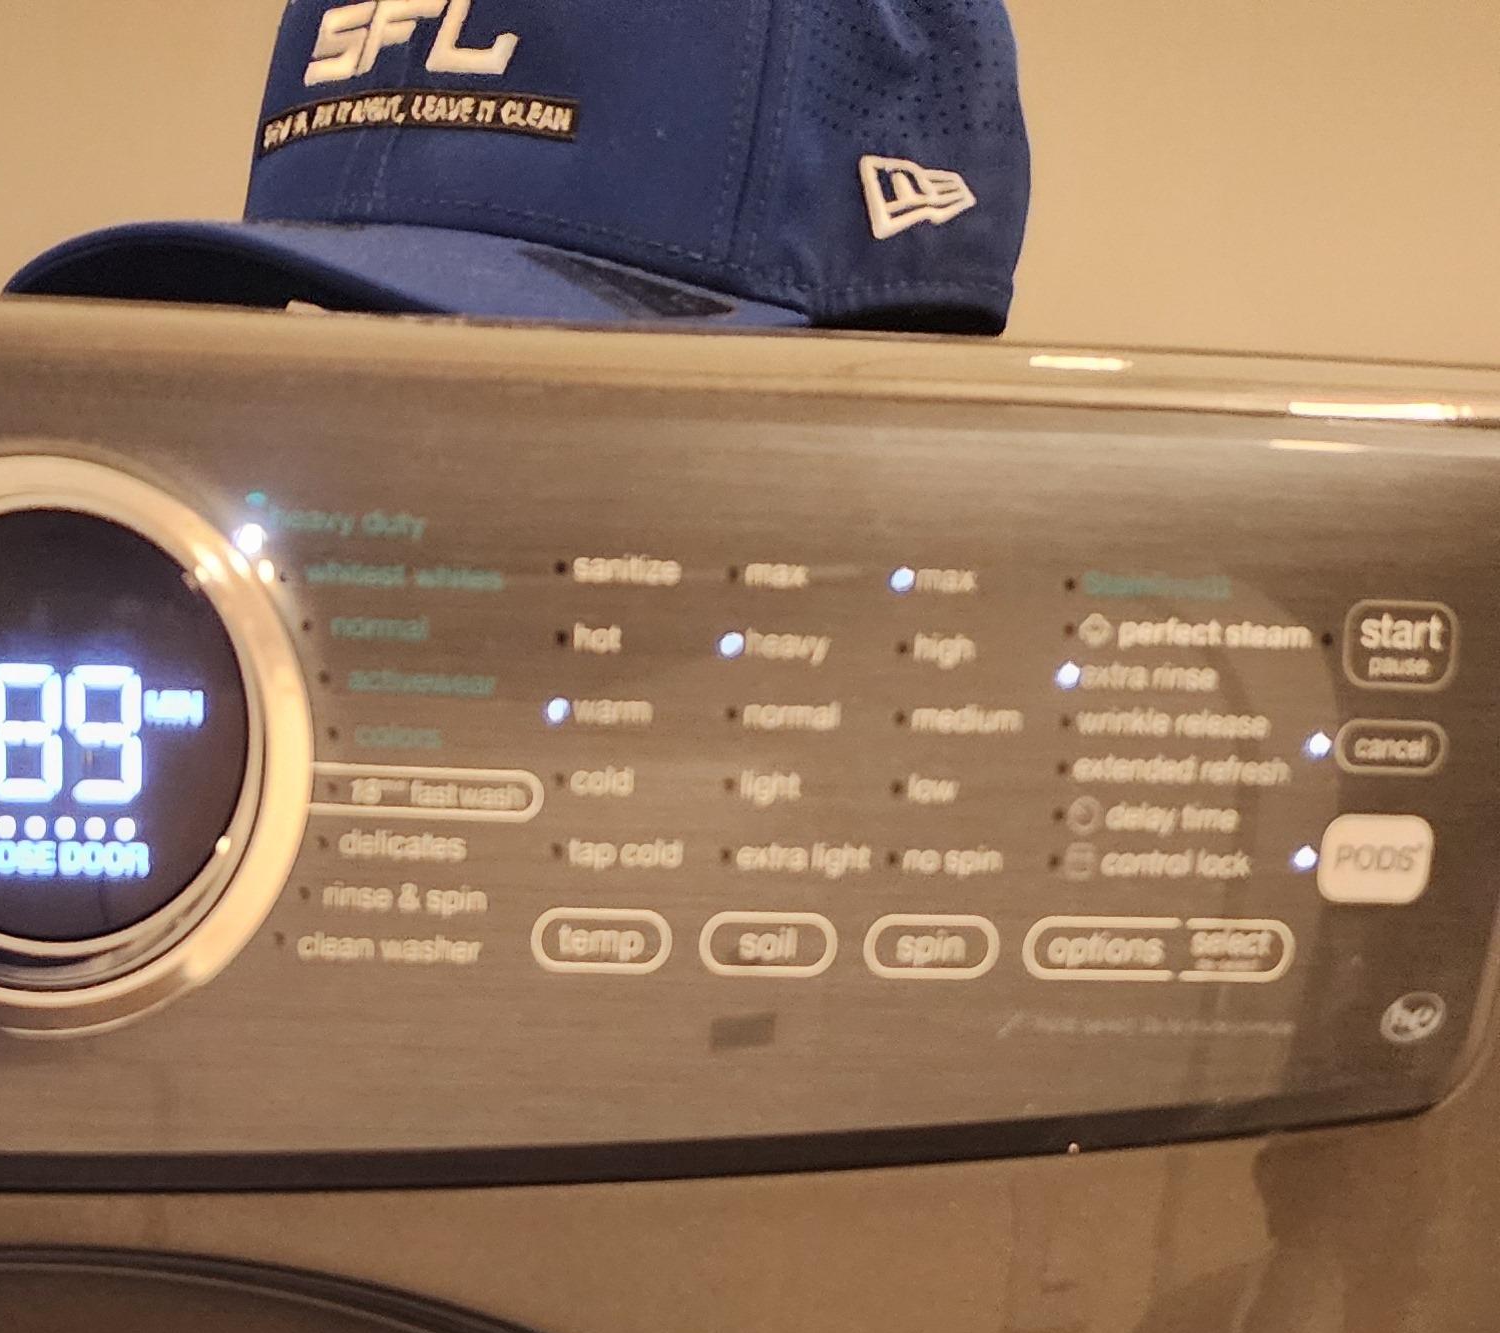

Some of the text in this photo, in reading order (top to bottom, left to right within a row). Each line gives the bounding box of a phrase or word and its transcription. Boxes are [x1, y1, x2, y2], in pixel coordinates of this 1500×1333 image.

[303, 0, 521, 87] SFL
[411, 95, 475, 125] LEAVE
[476, 99, 496, 124] IT
[501, 99, 574, 132] CLEAN
[573, 554, 682, 587] sanitize
[573, 622, 623, 654] hot
[746, 629, 832, 666] heavy
[1117, 617, 1312, 650] perfect steam
[1360, 612, 1444, 653] start
[913, 632, 977, 670] high
[1368, 656, 1432, 678] pause
[575, 699, 654, 726] warm
[742, 701, 842, 731] normal
[910, 704, 1024, 733] medium
[1353, 735, 1432, 763] cancel
[570, 766, 635, 798] cold
[739, 771, 802, 807] light
[907, 772, 960, 804] low
[58, 841, 149, 879] DOOR
[338, 830, 468, 862] delicates
[568, 838, 684, 871] tap cold
[735, 843, 872, 880] extra light
[902, 846, 1003, 878] no spin
[1334, 843, 1414, 872] PODS
[1197, 848, 1252, 880] lock
[322, 881, 489, 919] rinse & spin
[297, 933, 482, 964] clean washer
[558, 923, 646, 962] temp
[738, 925, 799, 961] soil
[895, 928, 968, 967] spin
[1047, 932, 1167, 967] options
[1190, 928, 1274, 959] select
